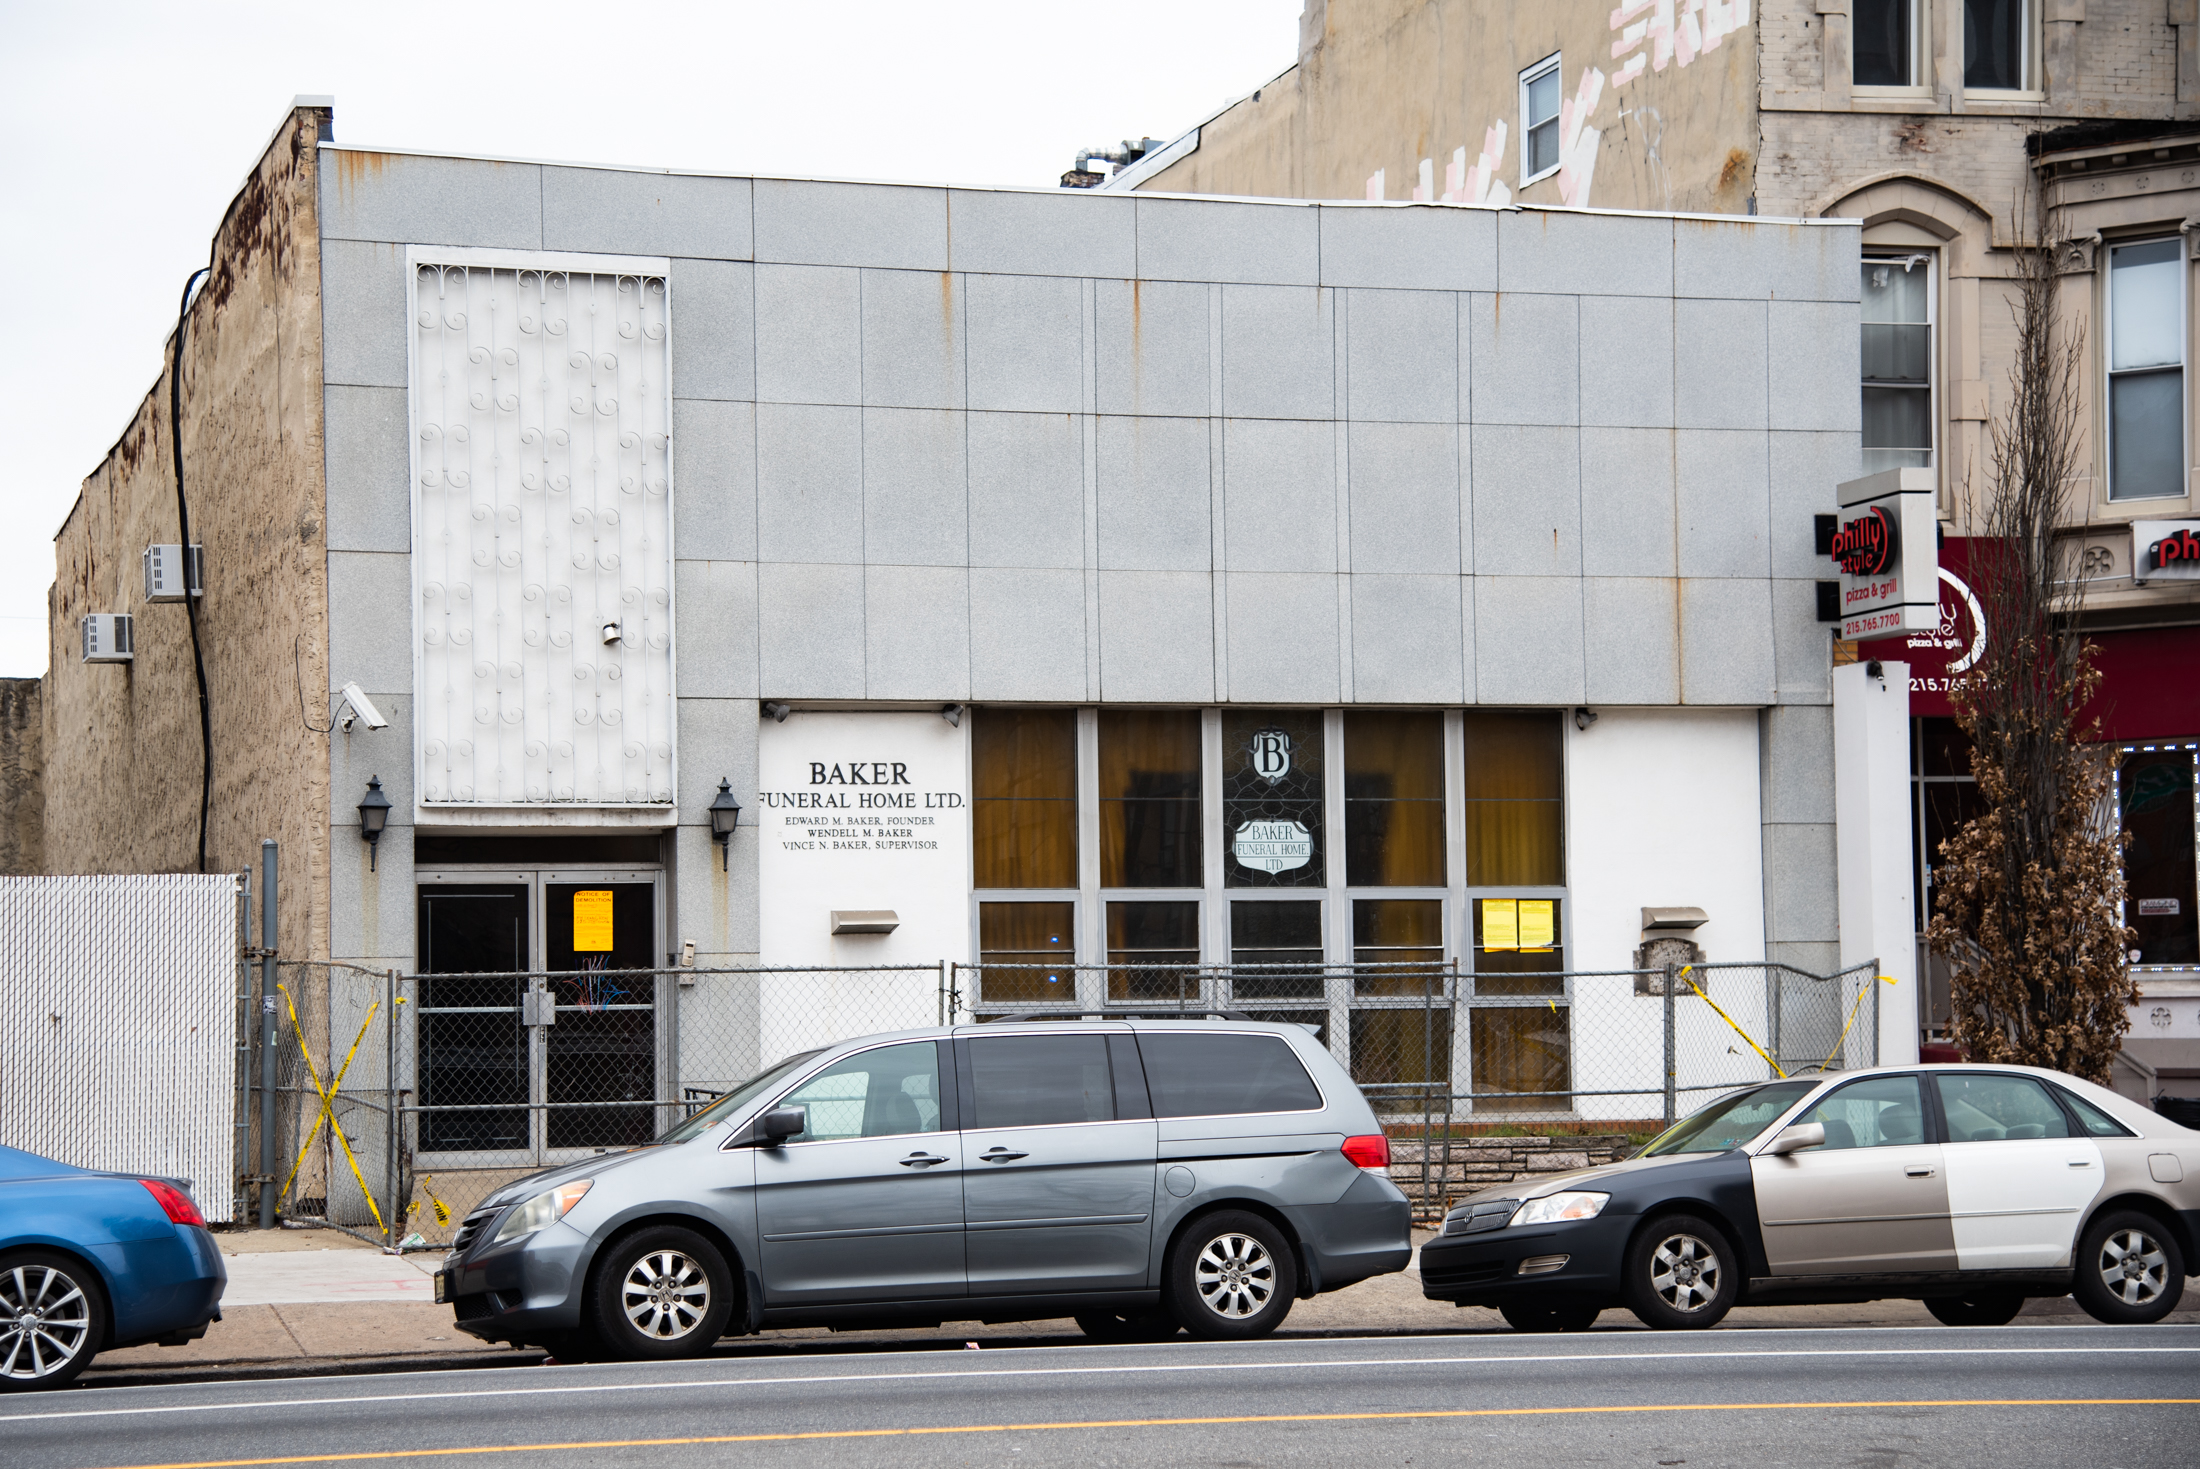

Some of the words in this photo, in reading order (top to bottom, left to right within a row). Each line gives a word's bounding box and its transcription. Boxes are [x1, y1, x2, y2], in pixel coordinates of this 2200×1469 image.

[1832, 516, 1880, 562] philly
[1841, 549, 1873, 576] style
[1846, 586, 1869, 606] pizza
[1871, 582, 1878, 597] &
[1880, 578, 1897, 599] grill
[1846, 612, 1900, 635] 215.765.7700
[1907, 638, 1933, 649] pizza
[1934, 638, 1943, 648] &
[1261, 737, 1285, 773] B
[809, 762, 911, 785] BAKER
[759, 792, 851, 808] FUNERAL
[858, 792, 917, 809] HOME
[924, 793, 966, 808] LTD.
[785, 816, 829, 826] EDWARD
[832, 817, 844, 826] M.
[847, 817, 884, 827] BAKER,
[887, 817, 935, 826] FOUNDER
[807, 828, 859, 838] WENDELL
[862, 828, 875, 837] M.
[878, 829, 913, 838] BAKER
[1252, 825, 1293, 840] BAKER
[782, 841, 815, 851] VINCE
[819, 841, 829, 850] N.
[832, 841, 871, 851] BAKER,
[875, 841, 938, 850] SUPERVISOR
[1237, 844, 1278, 855] FUNERAL
[1265, 859, 1283, 871] LTD
